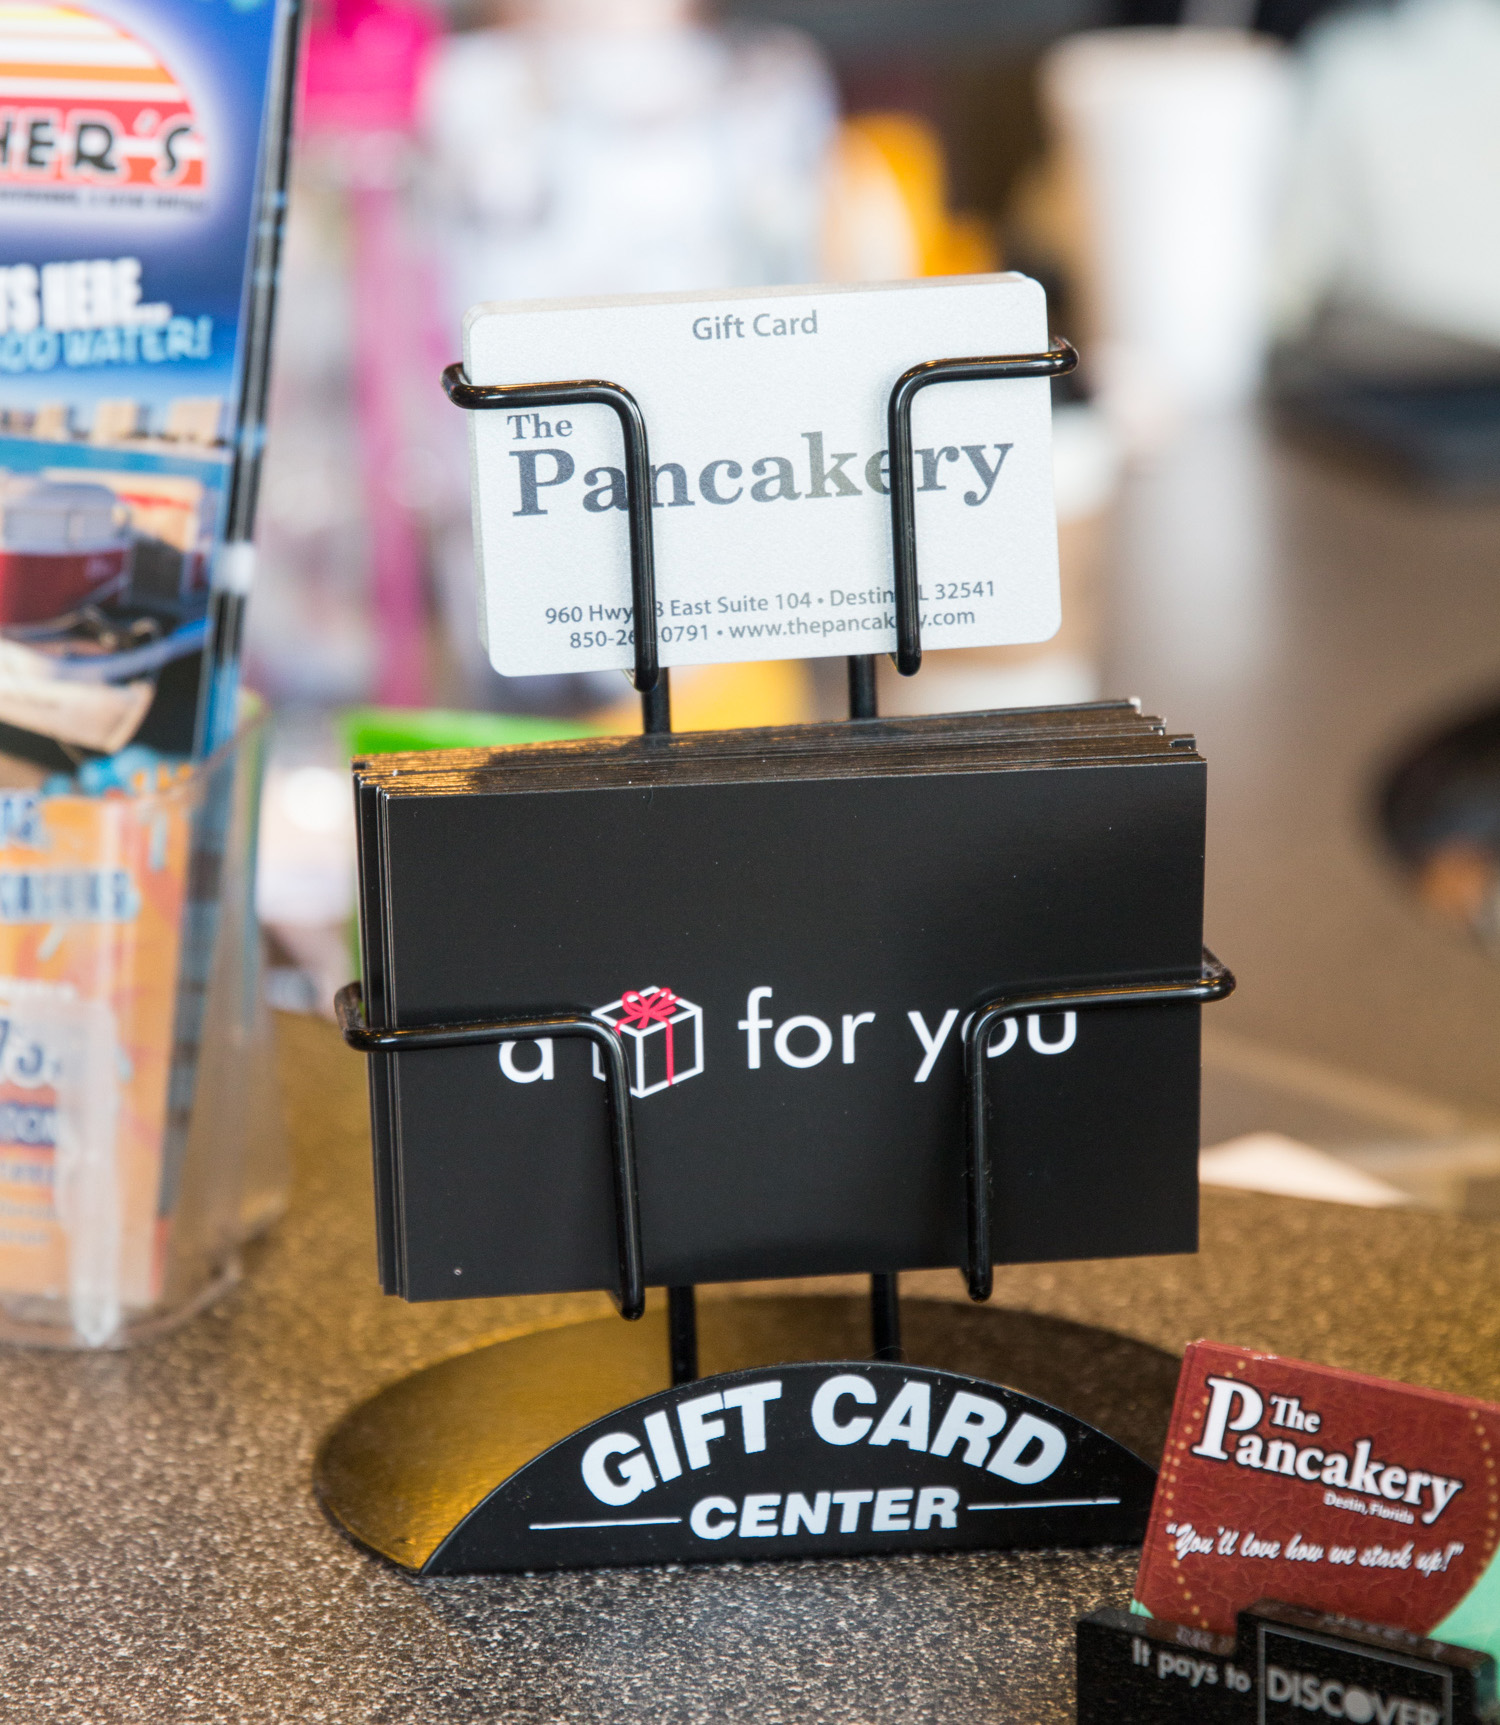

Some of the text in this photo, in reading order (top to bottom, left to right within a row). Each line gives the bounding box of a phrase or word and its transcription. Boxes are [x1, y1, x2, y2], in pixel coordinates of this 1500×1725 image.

[63, 314, 213, 367] WATER!
[692, 309, 818, 340] Gift Card
[507, 413, 573, 440] The
[508, 431, 1014, 517] Pancakery
[545, 606, 583, 625] 960
[589, 604, 634, 625] Hwy
[670, 599, 712, 617] East
[717, 594, 769, 614] Suite
[776, 592, 812, 611] 104
[935, 580, 994, 600] 32541
[728, 609, 976, 640] www.thepancaky.com
[498, 986, 1077, 1084] a for you
[1270, 1395, 1321, 1433] The
[581, 1374, 1067, 1506] GIFT CARD
[1192, 1376, 1463, 1525] Pancakery
[690, 1486, 960, 1540] CENTER
[1323, 1490, 1415, 1525] Destin, Florida
[1240, 1531, 1281, 1559] love
[1284, 1532, 1325, 1562] how
[1328, 1543, 1357, 1565] we
[1358, 1540, 1414, 1570] stack
[1131, 1638, 1440, 1725] It pays to DISCOVER
